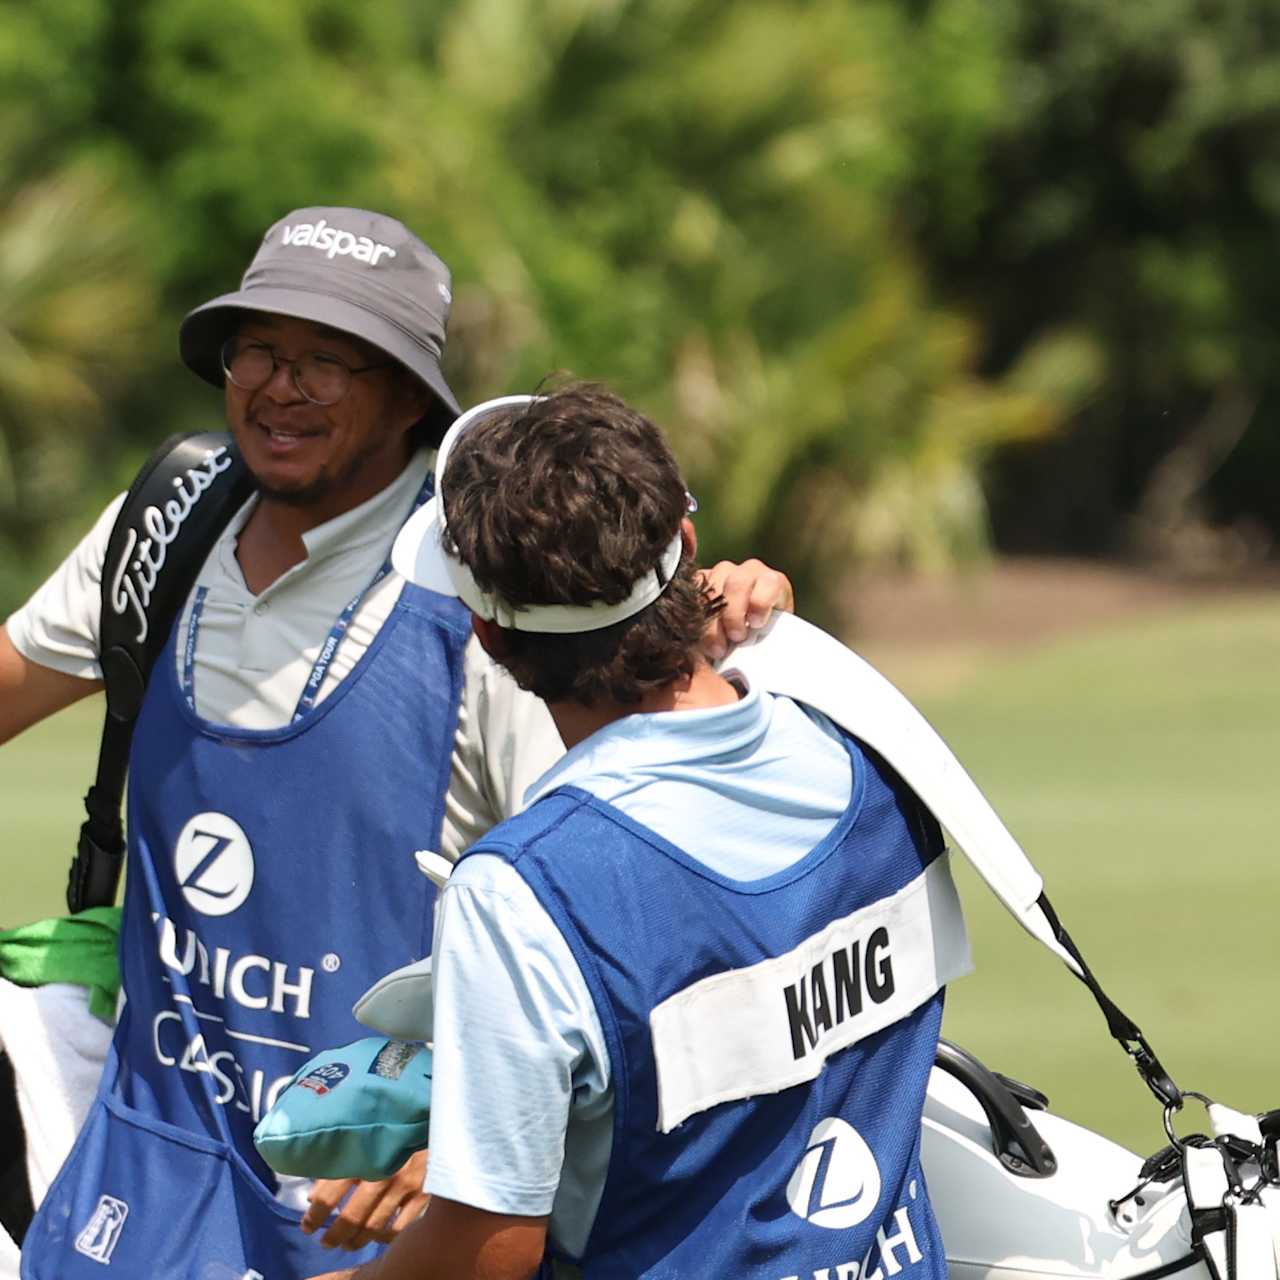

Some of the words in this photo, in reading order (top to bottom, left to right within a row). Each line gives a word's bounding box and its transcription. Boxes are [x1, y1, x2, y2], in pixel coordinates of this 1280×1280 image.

[281, 218, 391, 266] valspar
[111, 445, 233, 642] Titleist
[309, 665, 326, 689] PGA
[320, 636, 338, 666] TOUR
[783, 925, 896, 1061] KANG
